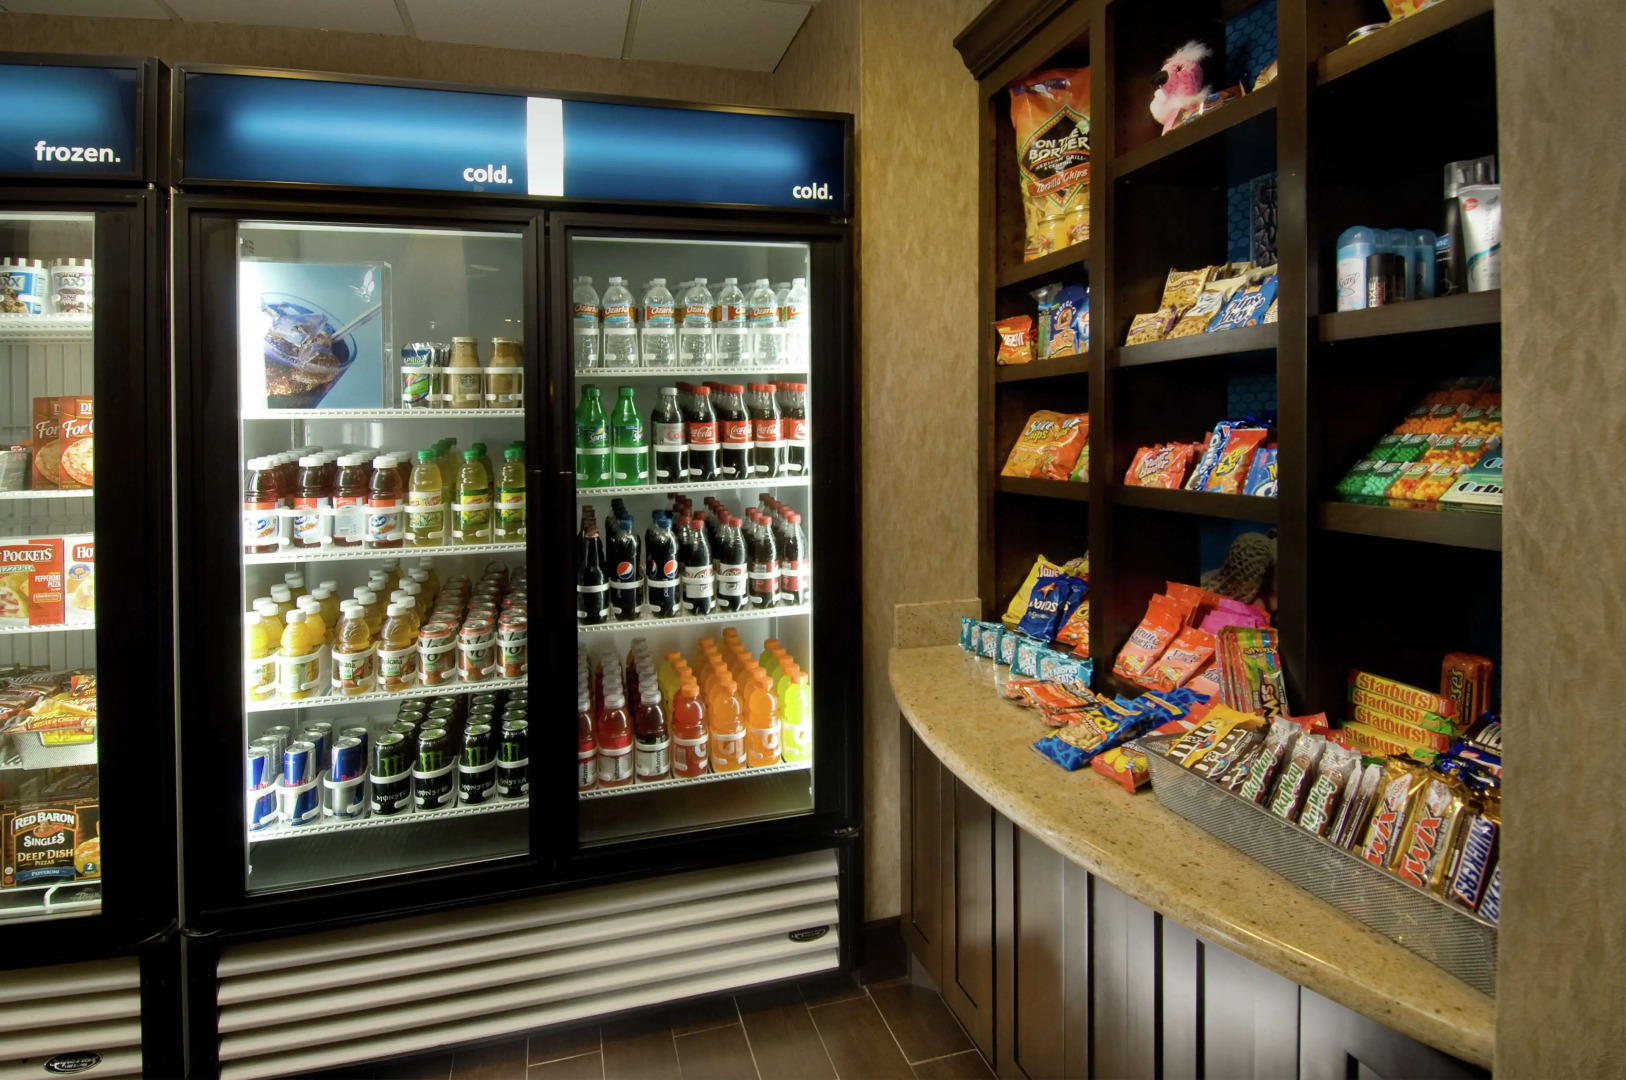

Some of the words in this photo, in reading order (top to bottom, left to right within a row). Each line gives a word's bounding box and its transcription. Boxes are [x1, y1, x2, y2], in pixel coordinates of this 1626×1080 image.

[1036, 140, 1056, 149] ON
[1059, 128, 1079, 146] THE
[35, 141, 121, 162] frozen.
[1029, 137, 1091, 161] BORDER
[463, 164, 513, 184] cold.
[793, 183, 833, 201] cold.
[62, 419, 88, 438] For
[2, 549, 53, 562] POCKETS
[35, 574, 61, 582] PEPPERONI
[1359, 674, 1433, 711] Starburst
[1353, 688, 1419, 723] Starburst
[1357, 707, 1427, 744] Starburst
[15, 815, 36, 830] RED
[37, 812, 74, 824] BARON
[24, 832, 65, 847] SINGLES
[17, 851, 45, 862] DEEP
[47, 849, 73, 859] DISH
[1454, 815, 1495, 905] SNICKERS
